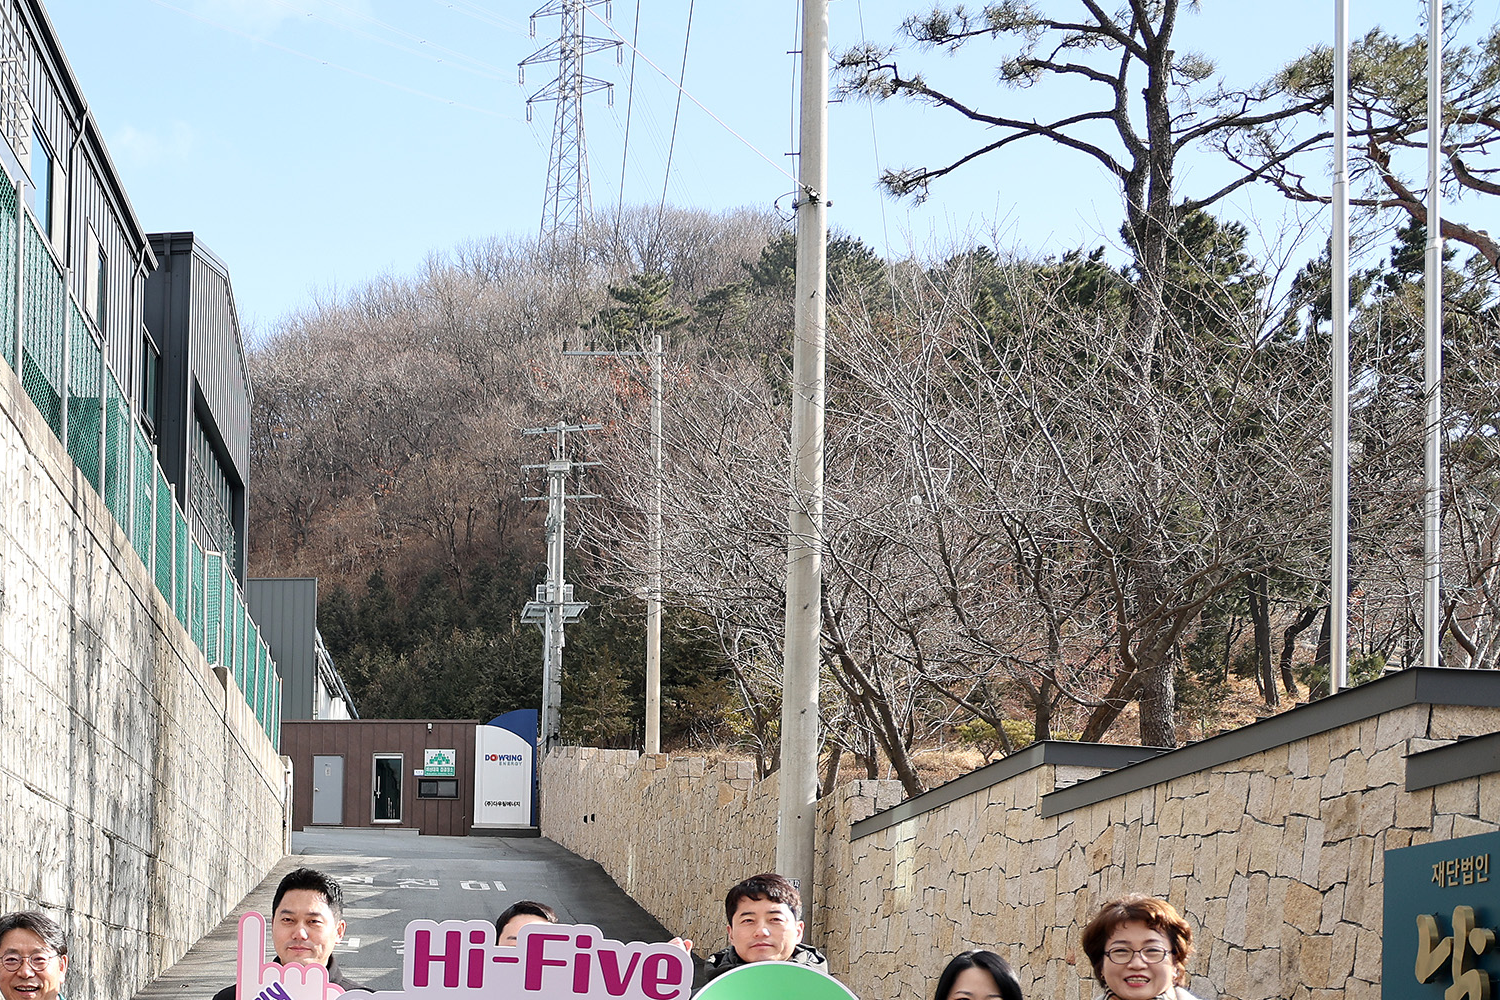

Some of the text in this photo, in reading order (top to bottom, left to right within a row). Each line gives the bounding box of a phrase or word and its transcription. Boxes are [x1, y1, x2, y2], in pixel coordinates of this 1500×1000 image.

[484, 754, 523, 762] DOWRING
[1431, 853, 1490, 888] 재단법인
[413, 929, 683, 1000] Hi-Five
